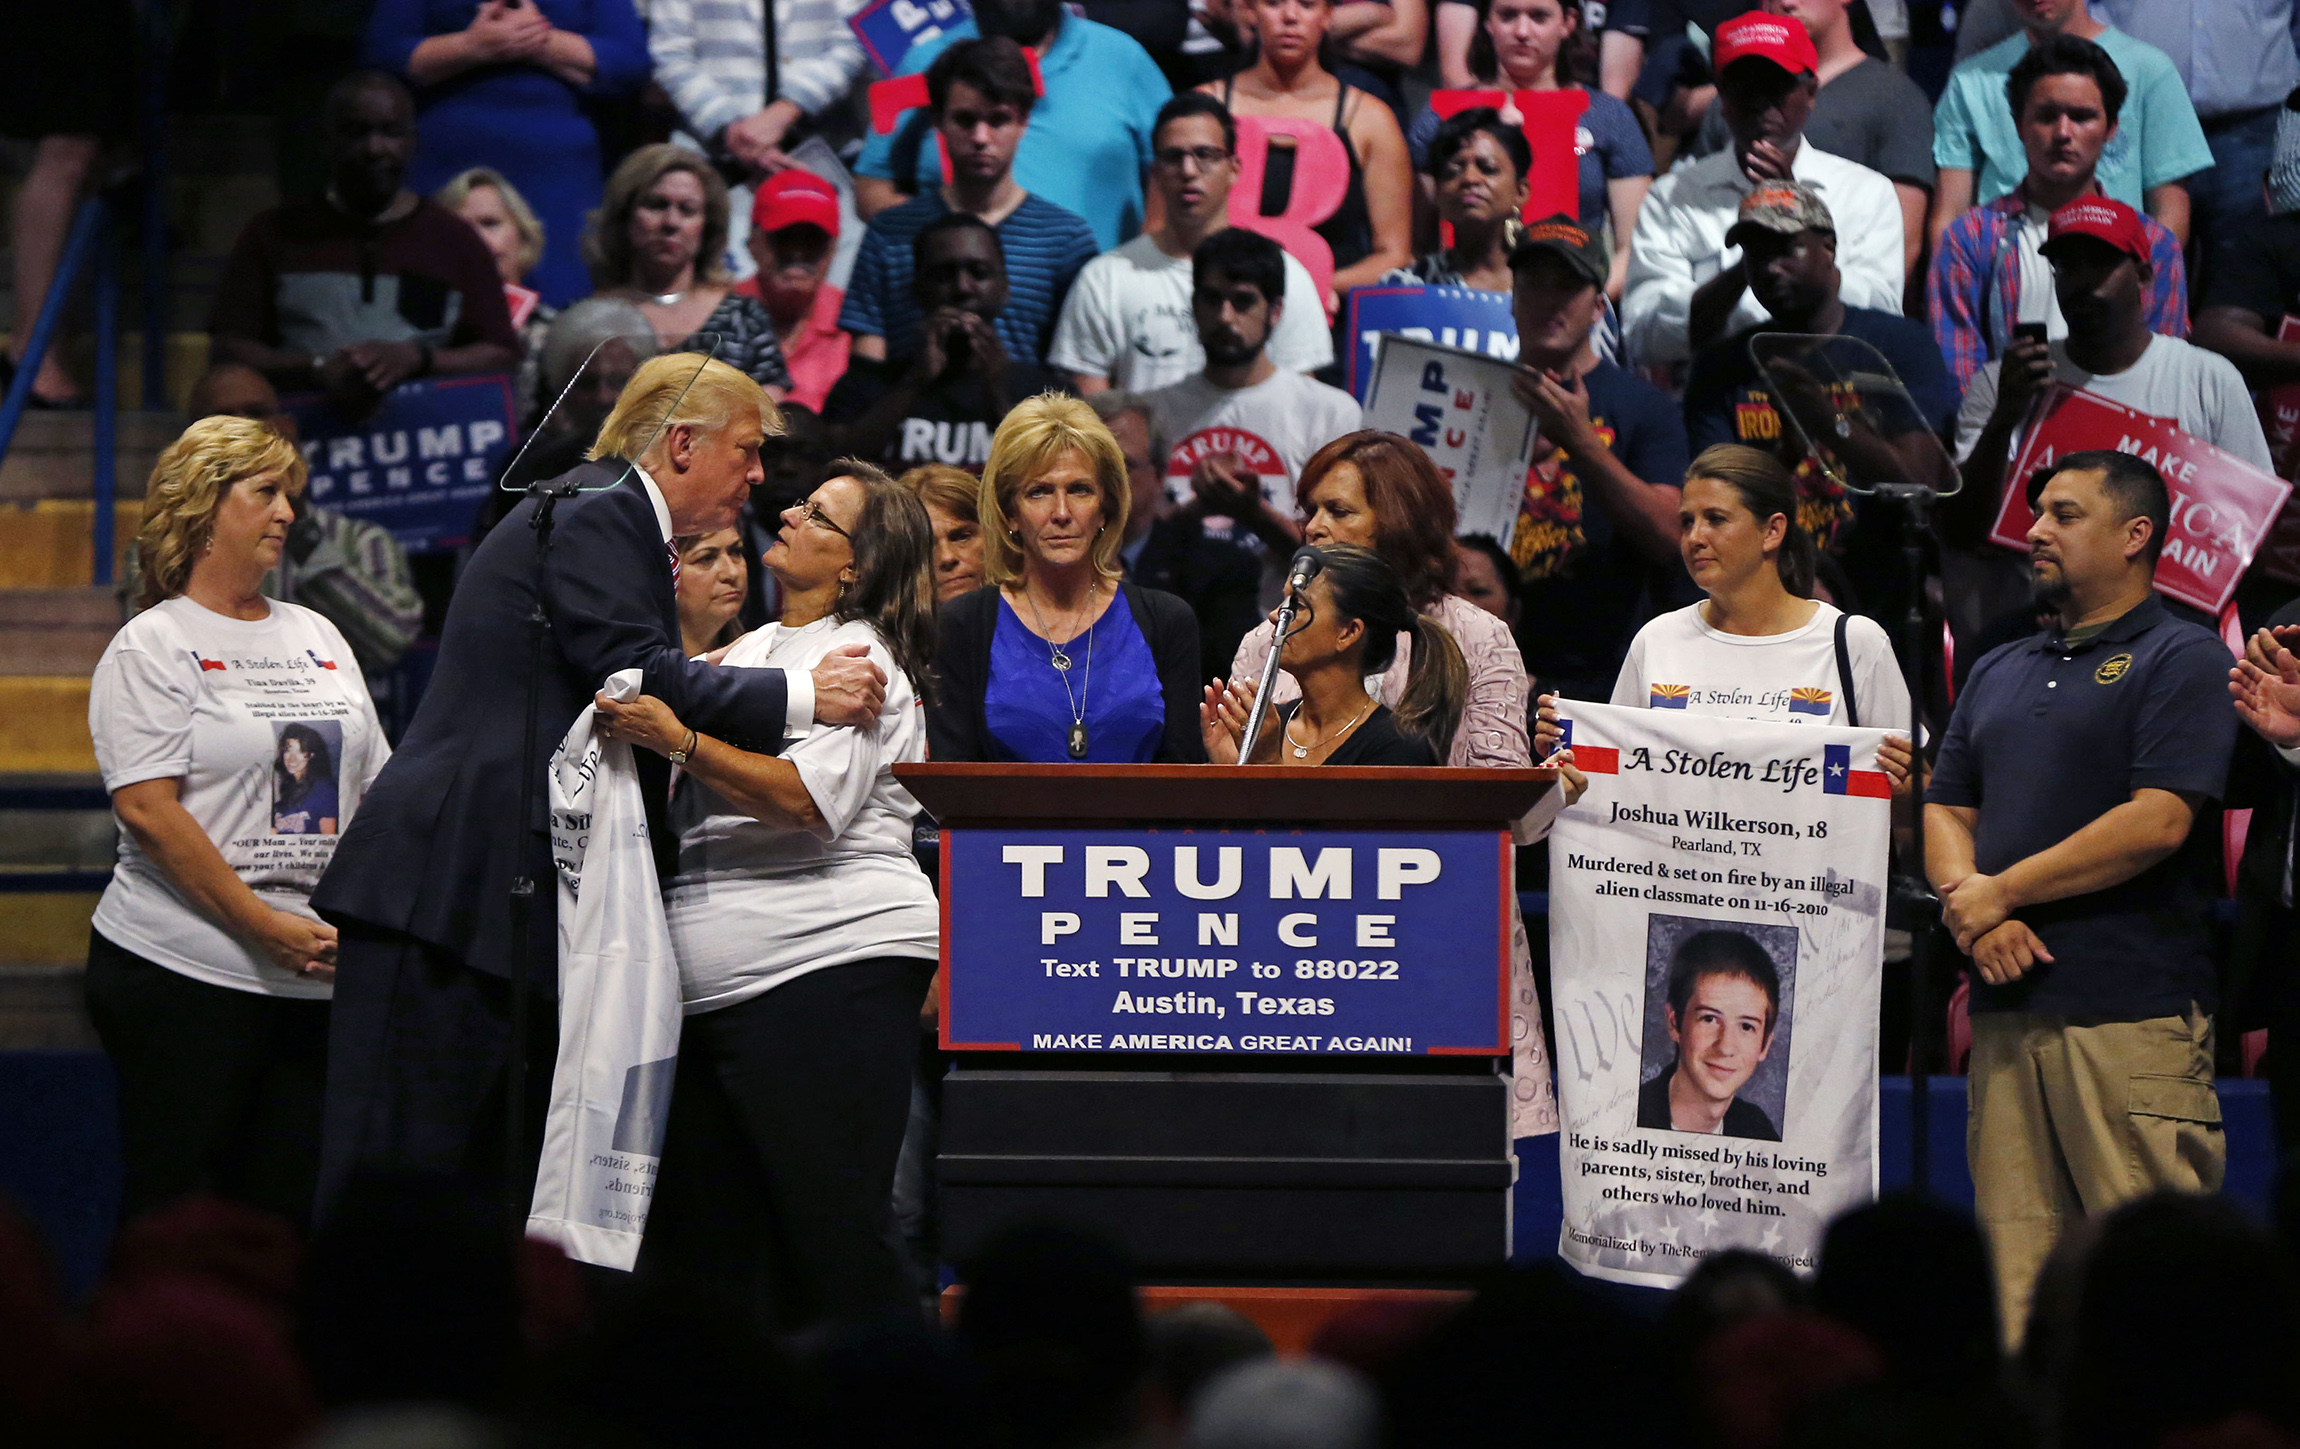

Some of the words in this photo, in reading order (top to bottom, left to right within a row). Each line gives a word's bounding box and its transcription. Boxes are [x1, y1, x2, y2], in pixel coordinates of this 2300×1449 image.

[900, 417, 994, 465] RUM
[1175, 431, 1270, 466] TRUMP
[2117, 434, 2198, 484] MAKE
[311, 457, 487, 499] PENCE
[2161, 537, 2218, 578] AIN
[247, 657, 284, 669] Stolen
[287, 657, 309, 673] Life
[1690, 691, 1702, 704] A
[1707, 688, 1752, 706] Stolen
[1757, 689, 1790, 712] Life
[1624, 747, 1653, 772] A
[1660, 748, 1753, 781] Stolen
[1760, 757, 1818, 793] Life
[565, 813, 593, 831] Sil
[1609, 801, 1679, 827] Joshua
[1685, 809, 1800, 839] Wilkerson,
[1807, 820, 1828, 839] 18
[262, 838, 286, 847] Mom
[1671, 836, 1737, 856] Pearland,
[1741, 841, 1762, 857] TX
[285, 861, 318, 870] children
[1002, 845, 1442, 900] TRUMP
[1567, 853, 1653, 877] Murdered
[1657, 863, 1669, 878] &
[1673, 866, 1698, 881] set
[1701, 870, 1723, 884] on
[1727, 868, 1758, 886] fire
[1761, 869, 1781, 891] by
[1784, 878, 1806, 891] an
[1809, 876, 1854, 897] illegal
[1595, 880, 1640, 899] alien
[1643, 884, 1725, 909] classmate
[1728, 896, 1751, 910] on
[1754, 898, 1829, 917] 11-16-2010
[1041, 911, 1396, 948] PENCE
[1040, 958, 1100, 978] Text
[1113, 958, 1239, 979] TRUMP
[1252, 960, 1281, 979] to
[1294, 959, 1400, 980] 88022
[1112, 990, 1226, 1020] Austin,
[1236, 991, 1336, 1016] Texas
[1033, 1034, 1103, 1050] MAKE
[1109, 1034, 1234, 1051] AMERICA
[1240, 1035, 1320, 1051] GREAT
[1327, 1036, 1412, 1052] AGAIN!
[1569, 1132, 1590, 1150] He
[1593, 1135, 1609, 1152] is
[1612, 1138, 1658, 1160] sadly
[1662, 1144, 1720, 1163] missed
[1723, 1148, 1742, 1169] by
[1745, 1150, 1769, 1168] his
[1772, 1152, 1828, 1177] loving
[1581, 1160, 1652, 1182] parents,
[1656, 1166, 1706, 1187] sister,
[1709, 1171, 1773, 1194] brother,
[1776, 1179, 1810, 1196] and
[1602, 1185, 1659, 1204] others
[1662, 1190, 1697, 1208] who
[1701, 1193, 1742, 1213] loved
[1746, 1196, 1786, 1217] him.
[1640, 1239, 1656, 1256] by
